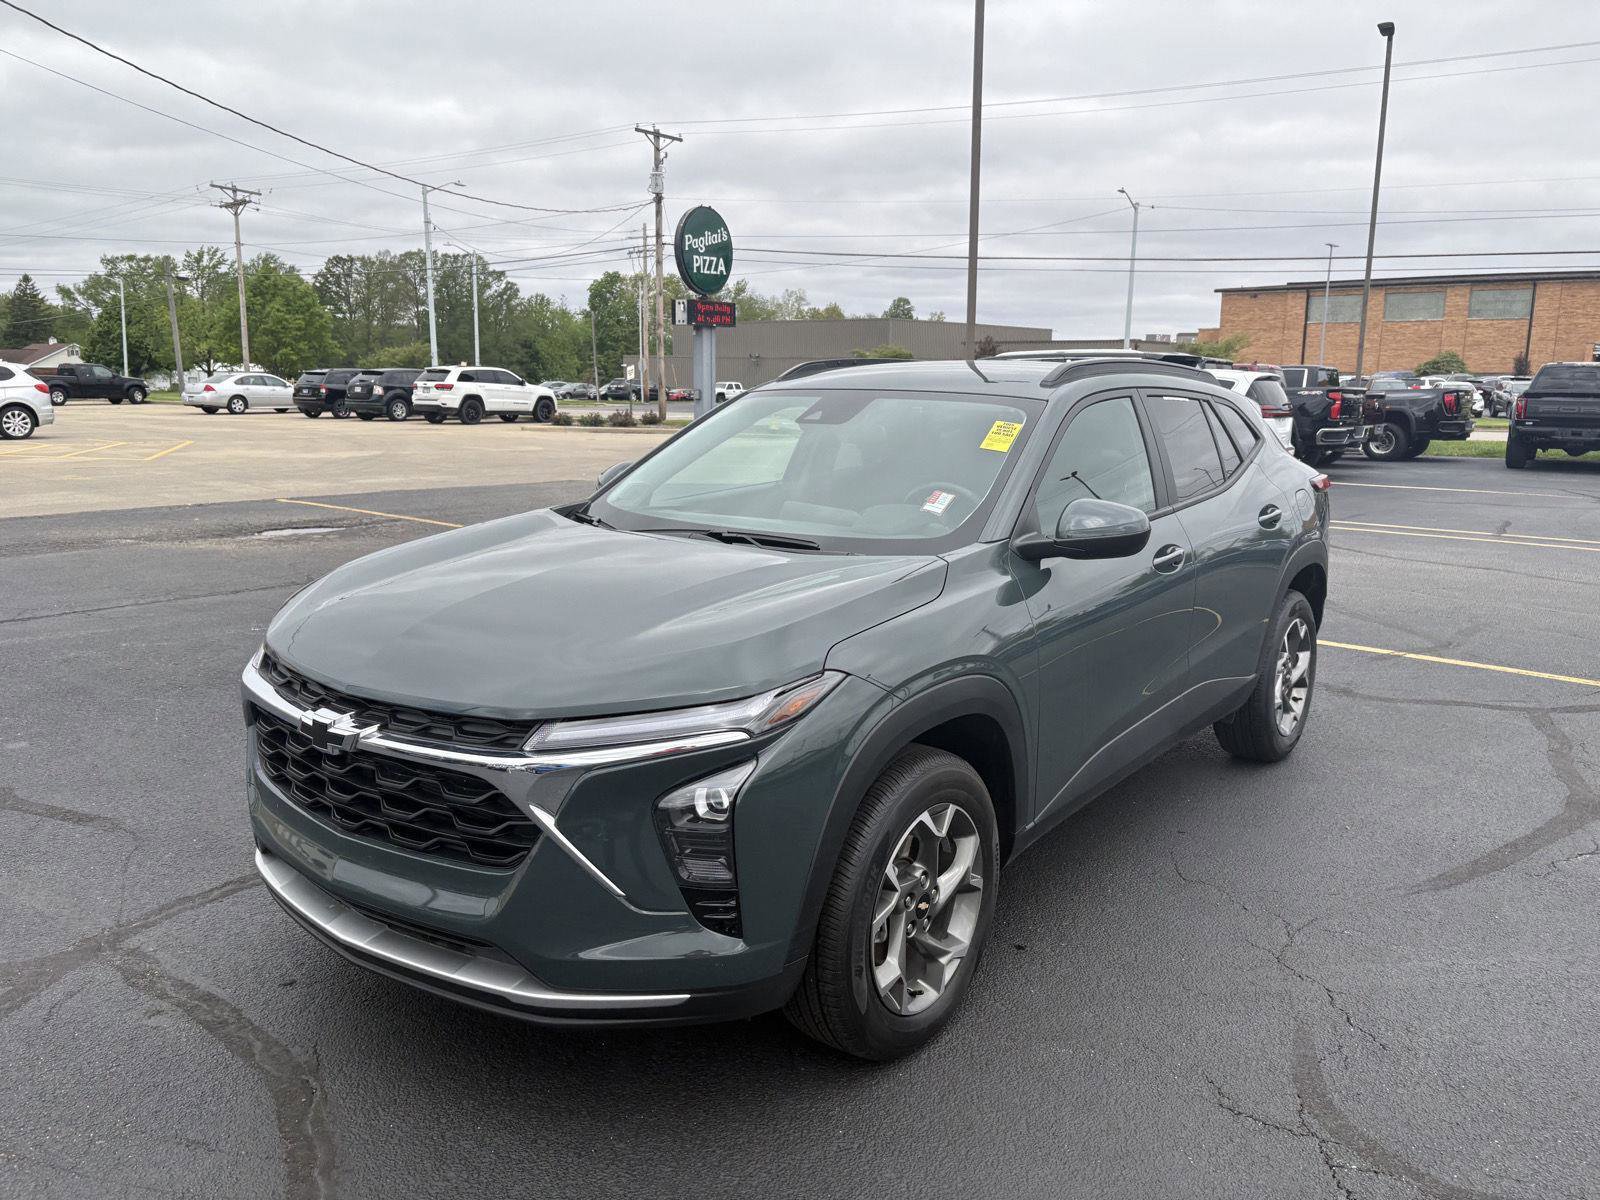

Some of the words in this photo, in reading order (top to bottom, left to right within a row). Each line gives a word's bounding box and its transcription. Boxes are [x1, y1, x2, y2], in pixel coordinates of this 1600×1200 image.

[685, 227, 728, 253] Pagliai's
[693, 255, 726, 275] PIZZA
[697, 303, 714, 313] Open
